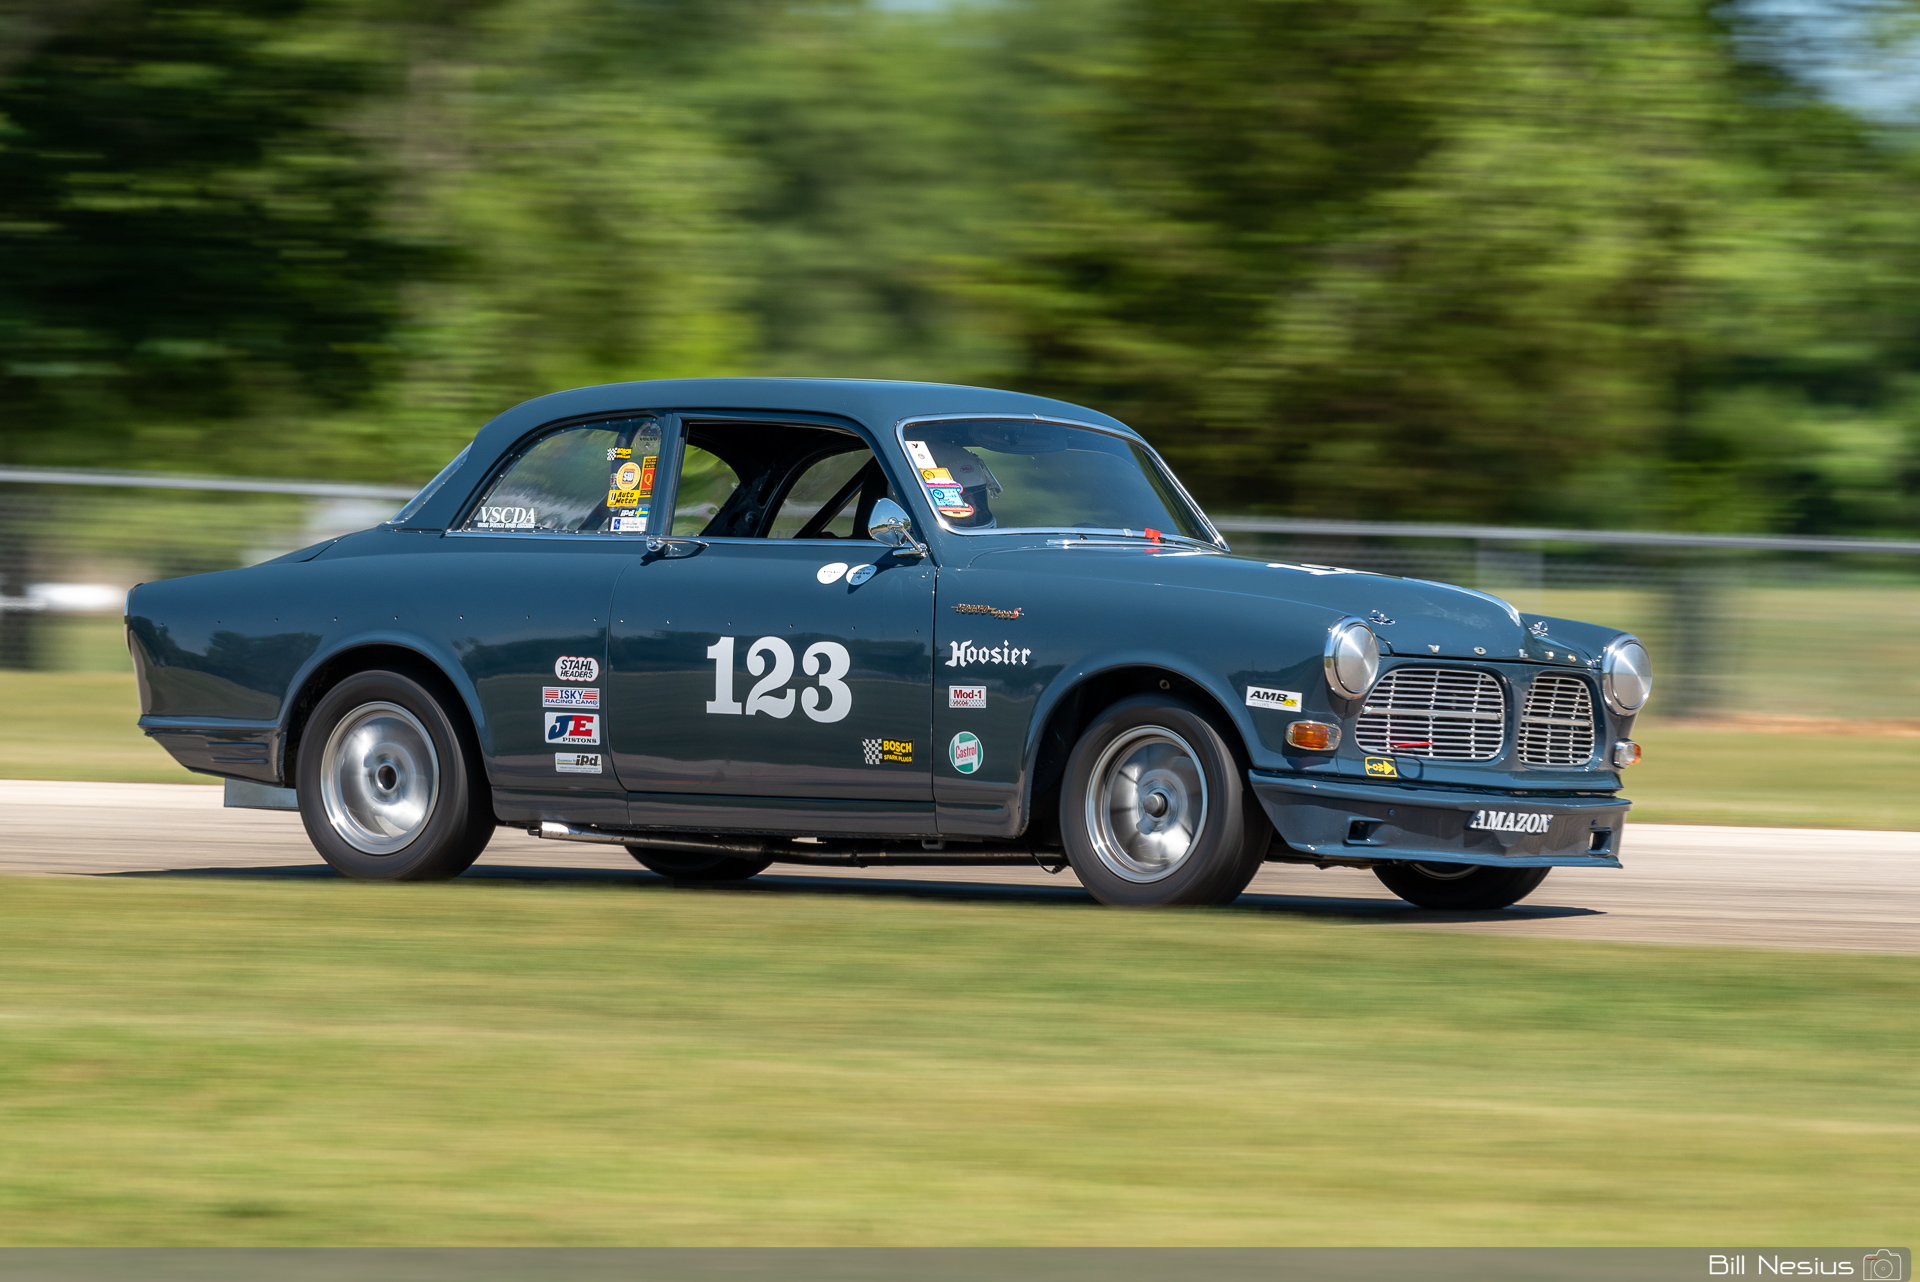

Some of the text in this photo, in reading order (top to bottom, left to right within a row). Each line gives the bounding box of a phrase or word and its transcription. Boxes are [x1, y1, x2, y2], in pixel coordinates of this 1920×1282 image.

[644, 472, 653, 486] Q
[615, 497, 636, 505] Meter
[480, 506, 535, 523] VSCDA
[944, 639, 1032, 668] Hoosier
[560, 659, 593, 671] STAHL
[560, 670, 593, 679] HEADERS
[706, 635, 852, 723] 123
[559, 689, 584, 700] ISKY
[953, 689, 982, 699] Mod-1
[1250, 690, 1288, 702] AMB
[548, 714, 594, 741] JE
[883, 740, 912, 754] BOSCH
[955, 741, 977, 760] Castrol
[1469, 809, 1554, 834] AMAZON
